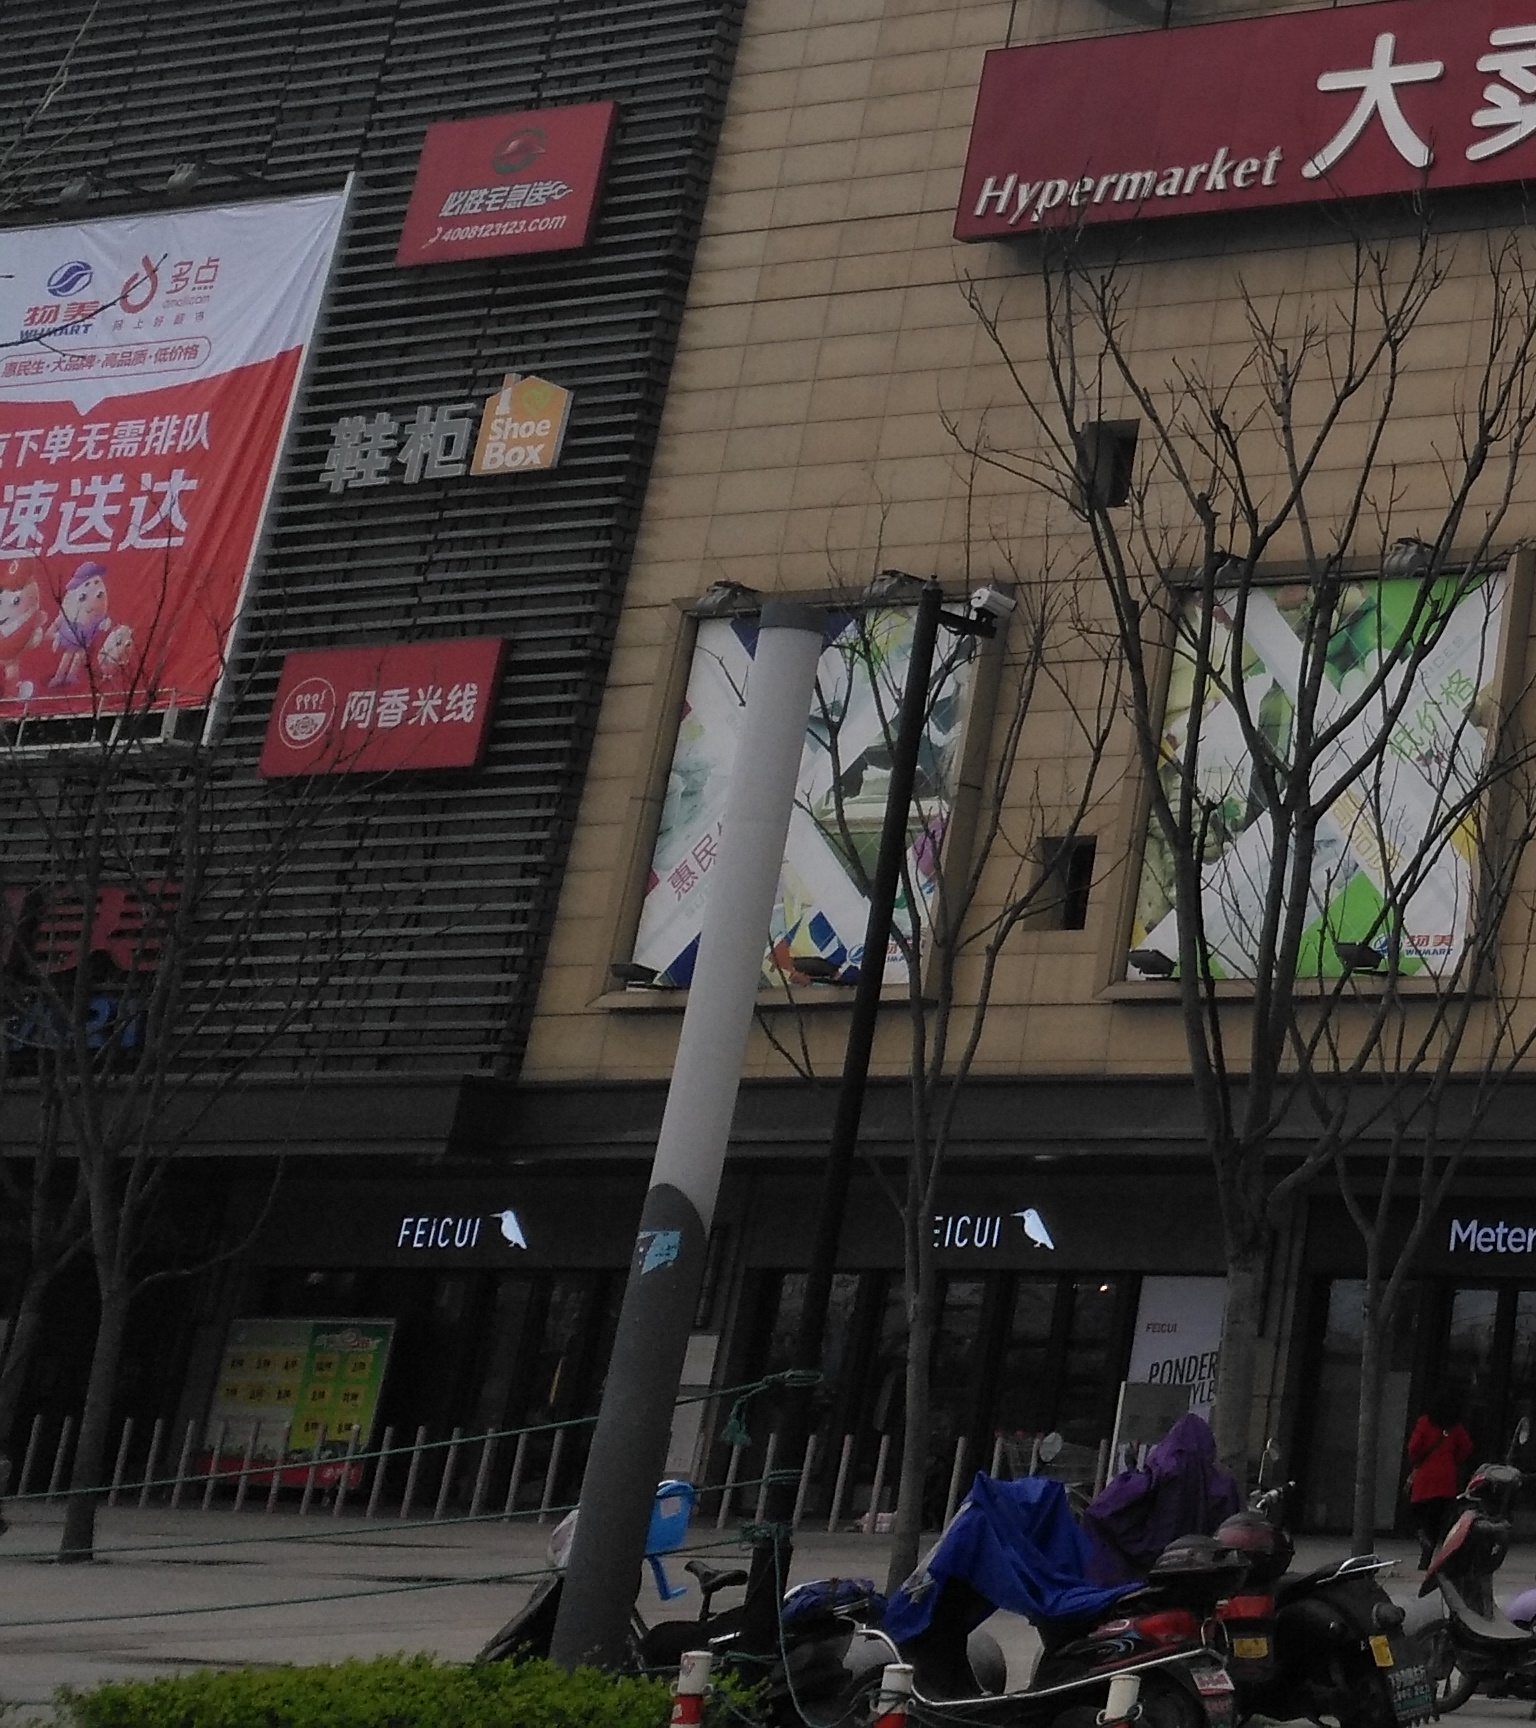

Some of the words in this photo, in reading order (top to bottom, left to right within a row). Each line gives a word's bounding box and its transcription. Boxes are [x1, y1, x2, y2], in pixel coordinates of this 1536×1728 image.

[972, 145, 1284, 227] Hypermarket
[441, 215, 568, 243] 4008123123.com
[165, 256, 220, 294] 多点
[24, 300, 100, 326] 物美
[319, 403, 473, 493] 鞋柜
[488, 417, 551, 450] Shoe
[480, 441, 545, 470] Box
[0, 468, 198, 559] 速送达
[340, 683, 478, 731] 阿香米线
[1389, 668, 1475, 765] 低价格
[666, 821, 724, 902] 惠民
[397, 1217, 482, 1249] FEICUI
